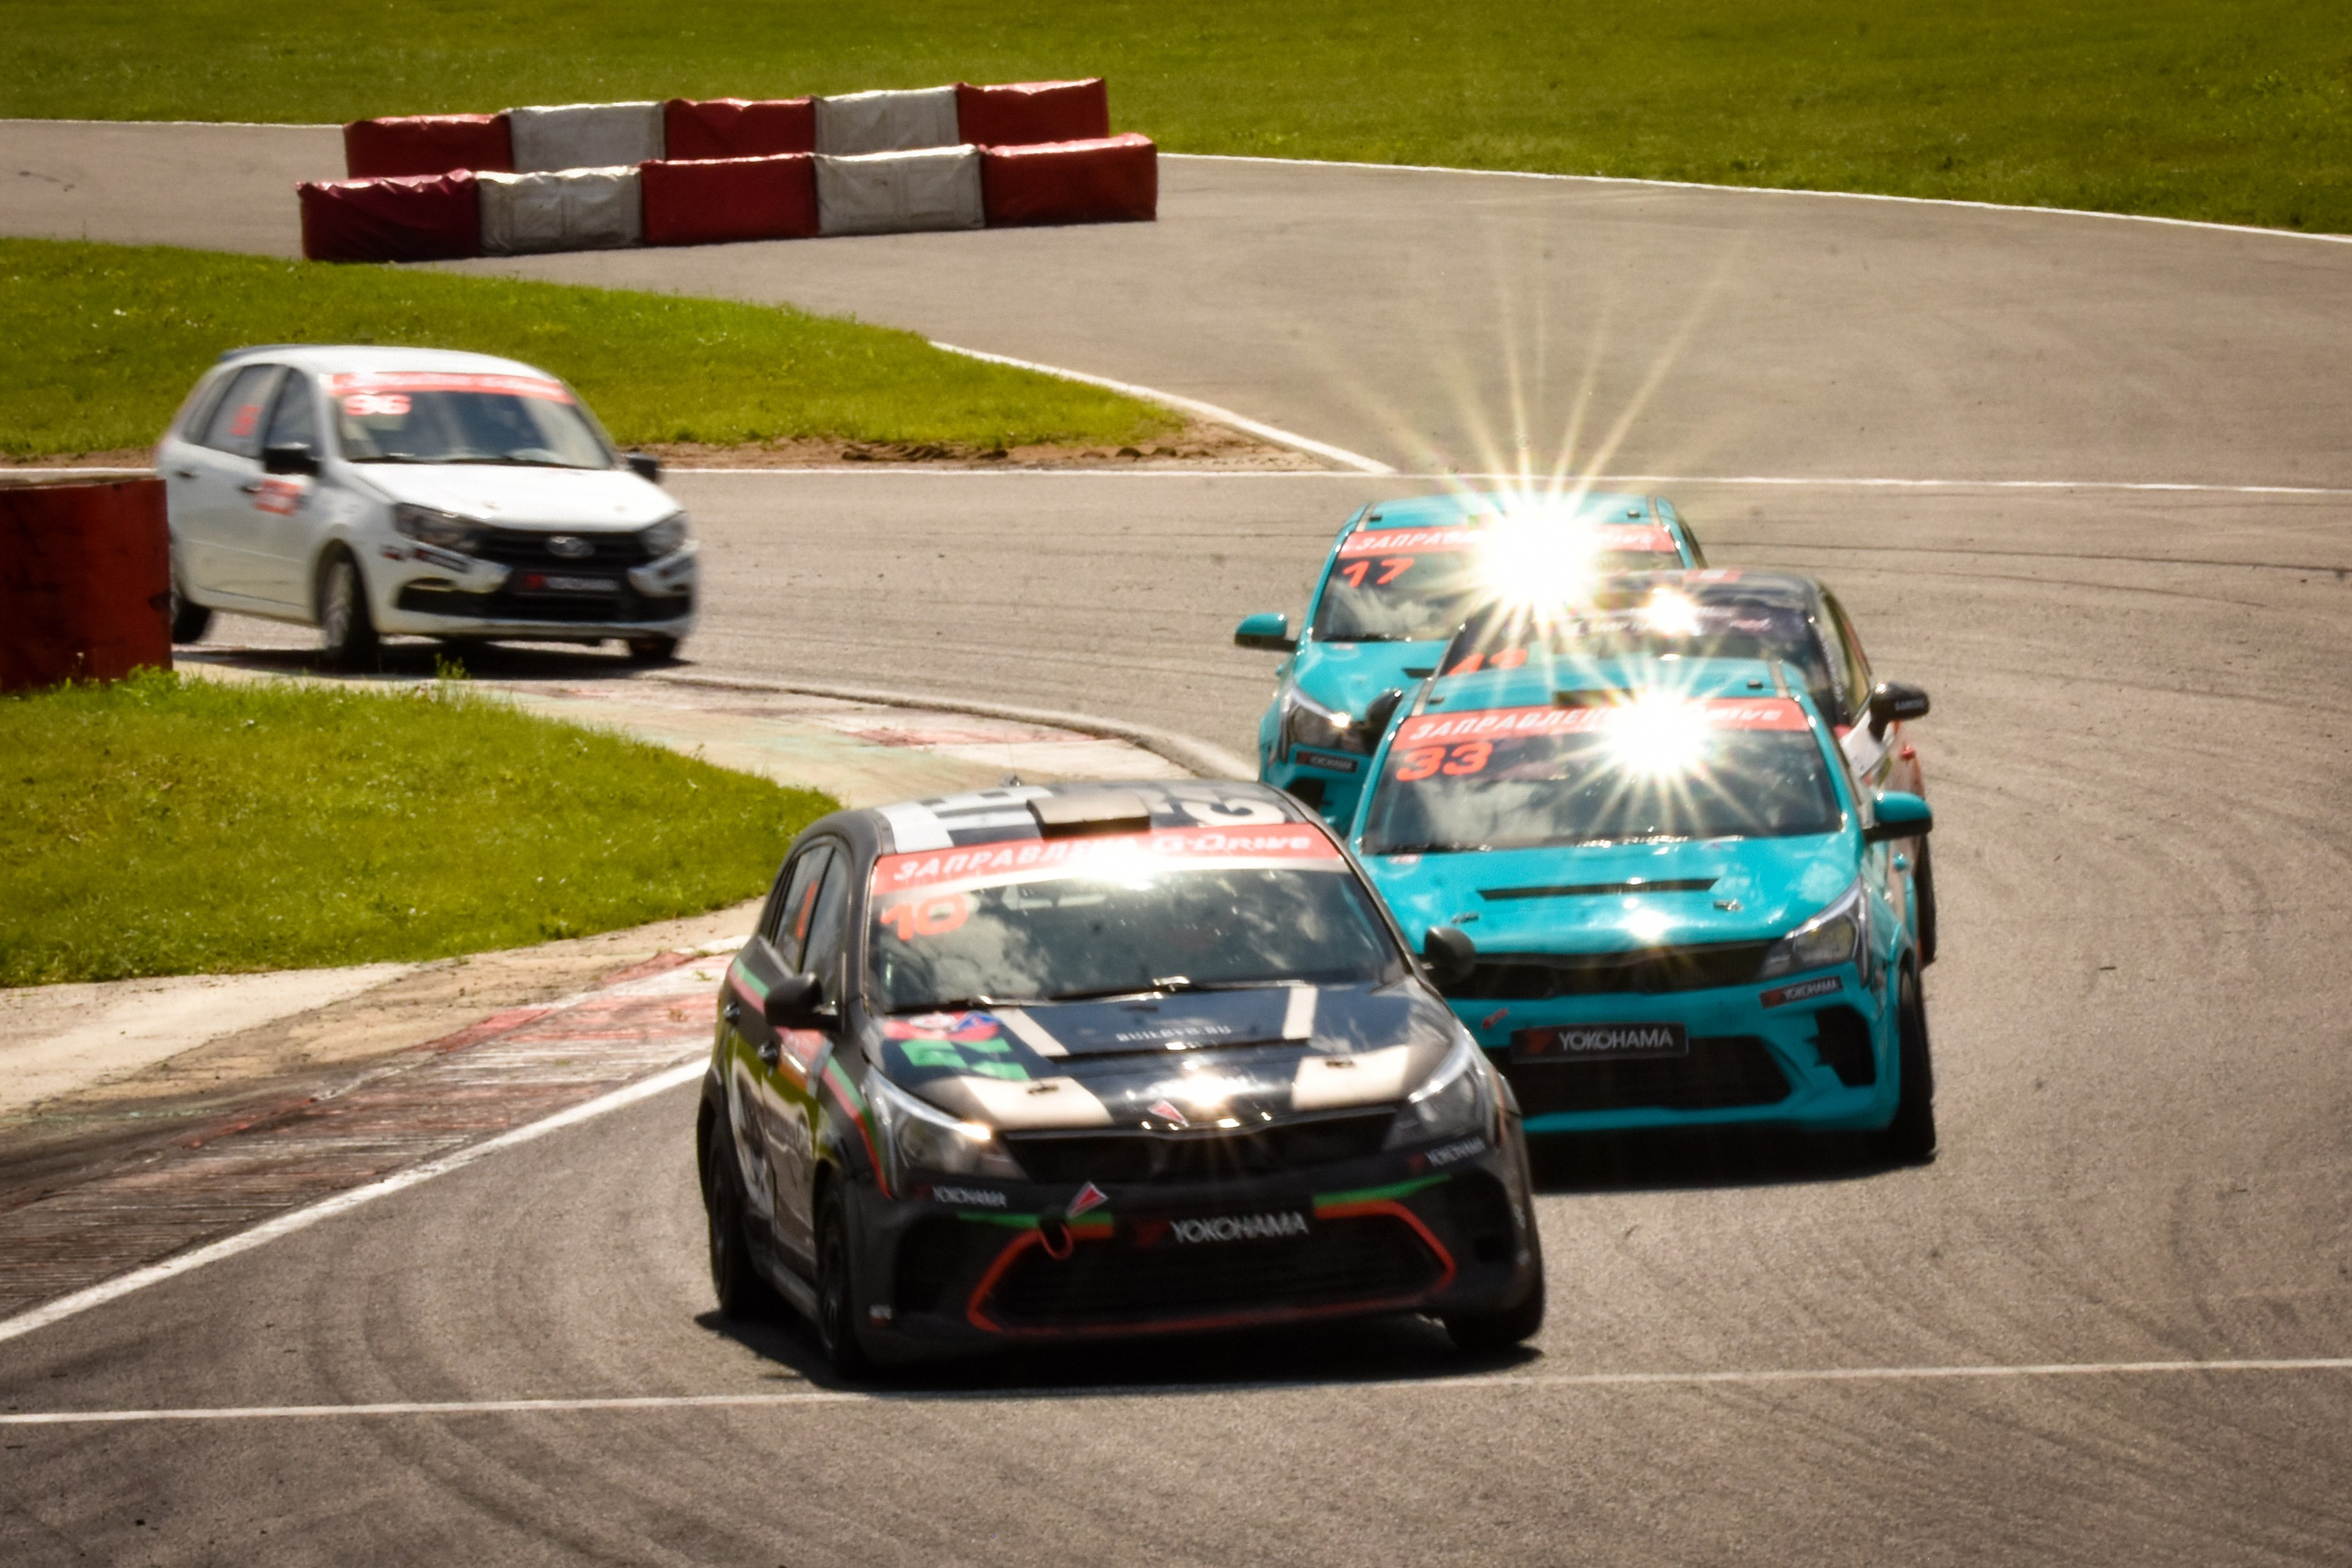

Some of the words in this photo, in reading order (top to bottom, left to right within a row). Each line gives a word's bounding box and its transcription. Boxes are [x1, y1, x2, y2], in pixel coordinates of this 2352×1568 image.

[1342, 558, 1415, 589] 17
[1408, 705, 1619, 741] ЗАПРАВЛЕН
[1396, 741, 1494, 783] 33
[879, 894, 969, 942] 10
[1783, 978, 1839, 1001] YOKOHAMA
[1558, 1027, 1674, 1052] YOKOHAMA
[932, 1184, 1008, 1208] YOKOHAMA
[1170, 1210, 1310, 1244] YOKOHAMA
